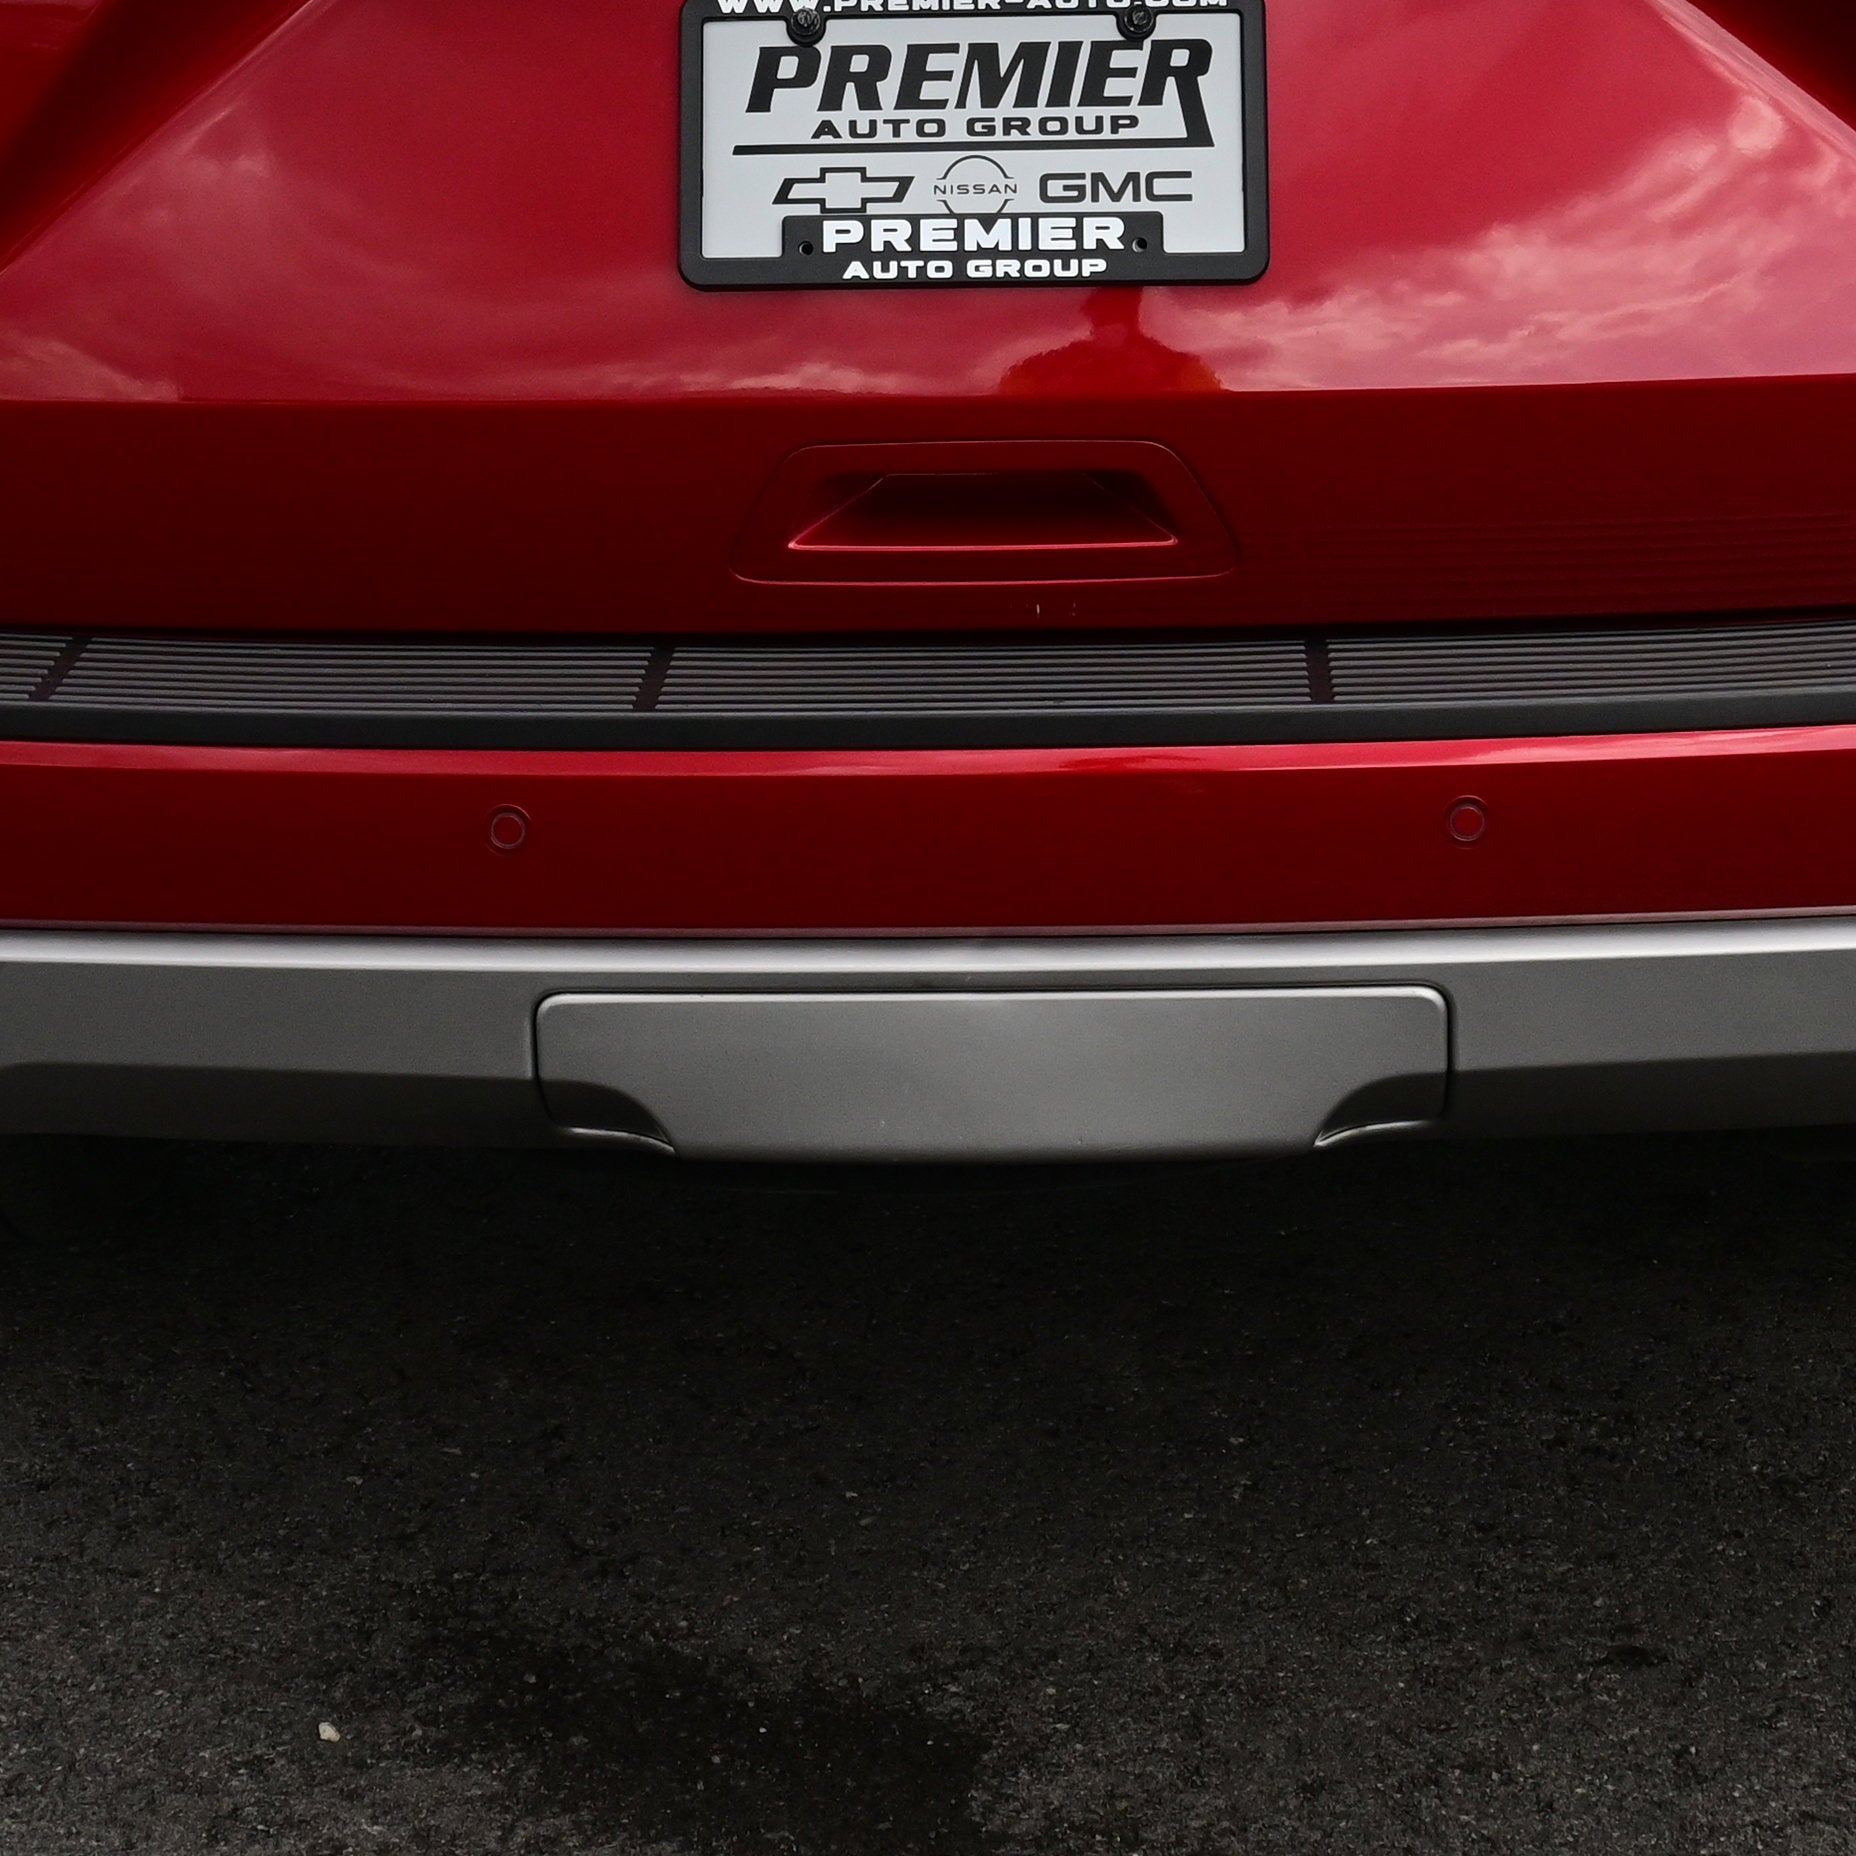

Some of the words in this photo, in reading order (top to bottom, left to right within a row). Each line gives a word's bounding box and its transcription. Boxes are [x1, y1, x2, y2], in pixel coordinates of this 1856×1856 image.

[744, 38, 1214, 136] PREMIER
[810, 117, 947, 140] AUTO
[965, 114, 1140, 137] GROUP
[933, 182, 1018, 196] NISSAN
[1039, 170, 1193, 204] GMC
[822, 217, 1126, 253] PREMIER
[842, 259, 954, 280] AUTO
[966, 258, 1108, 278] GROUP
